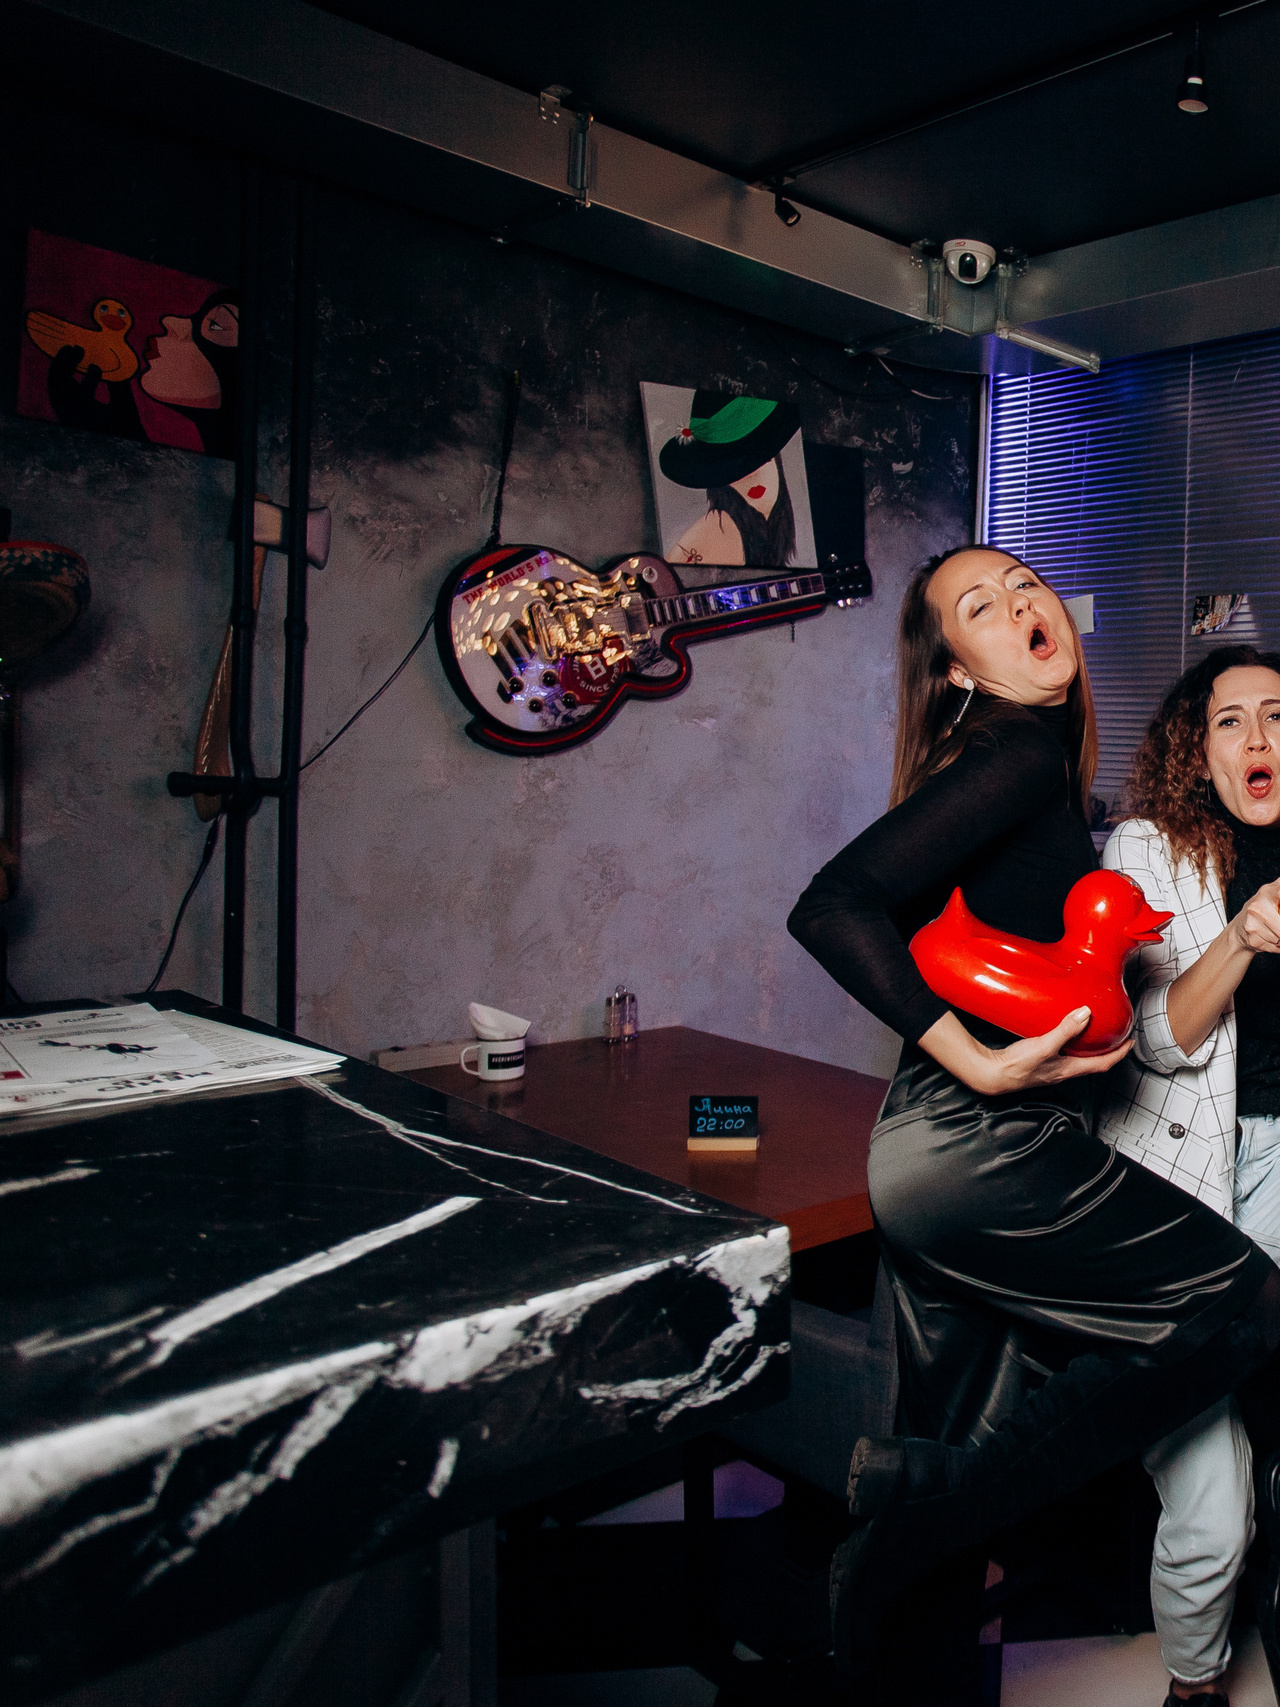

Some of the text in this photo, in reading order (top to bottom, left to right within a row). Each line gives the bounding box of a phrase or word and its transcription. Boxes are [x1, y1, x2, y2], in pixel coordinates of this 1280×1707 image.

[462, 588, 484, 604] THE
[487, 562, 534, 590] WORLD'S
[585, 656, 607, 680] B
[579, 680, 610, 693] SINCE
[696, 1117, 745, 1132] 22:00
